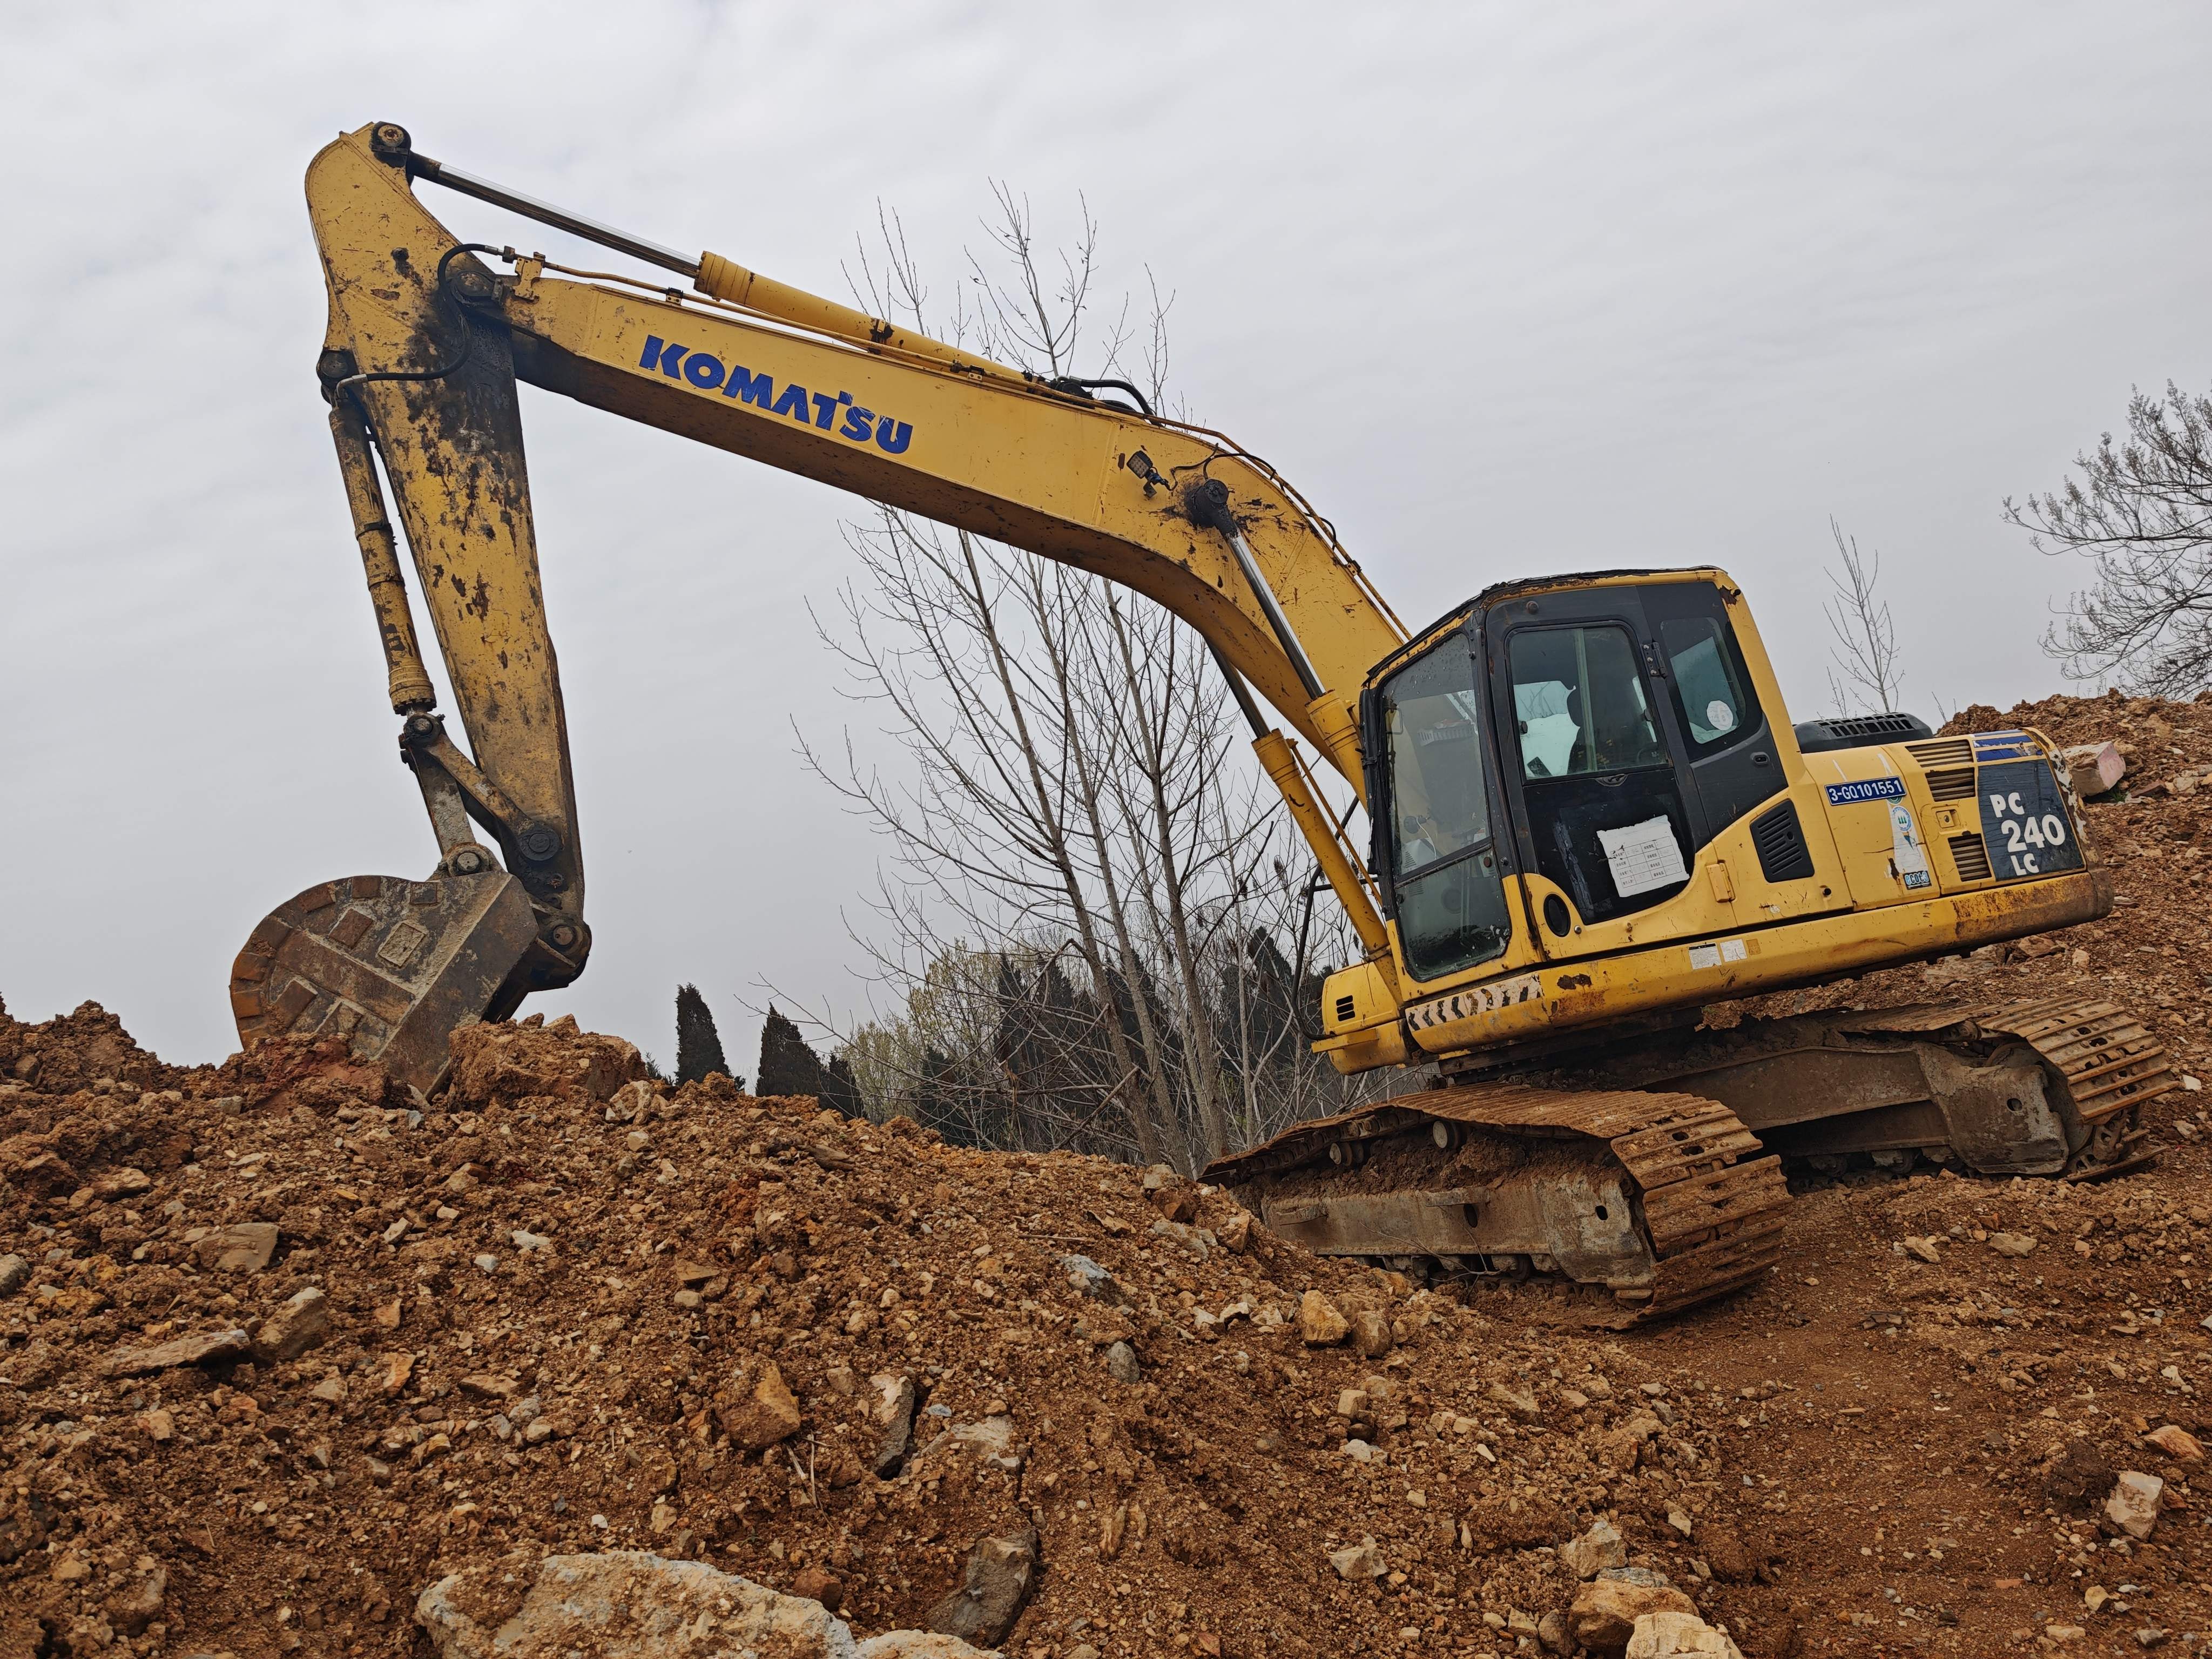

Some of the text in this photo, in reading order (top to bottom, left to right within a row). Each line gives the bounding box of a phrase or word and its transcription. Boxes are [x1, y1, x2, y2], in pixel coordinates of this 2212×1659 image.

[639, 334, 913, 454] KOMATSU
[1829, 780, 1902, 801] 3-GQ101551
[1990, 792, 2025, 818] PC
[2001, 814, 2066, 853] 240
[2010, 853, 2039, 876] LC
